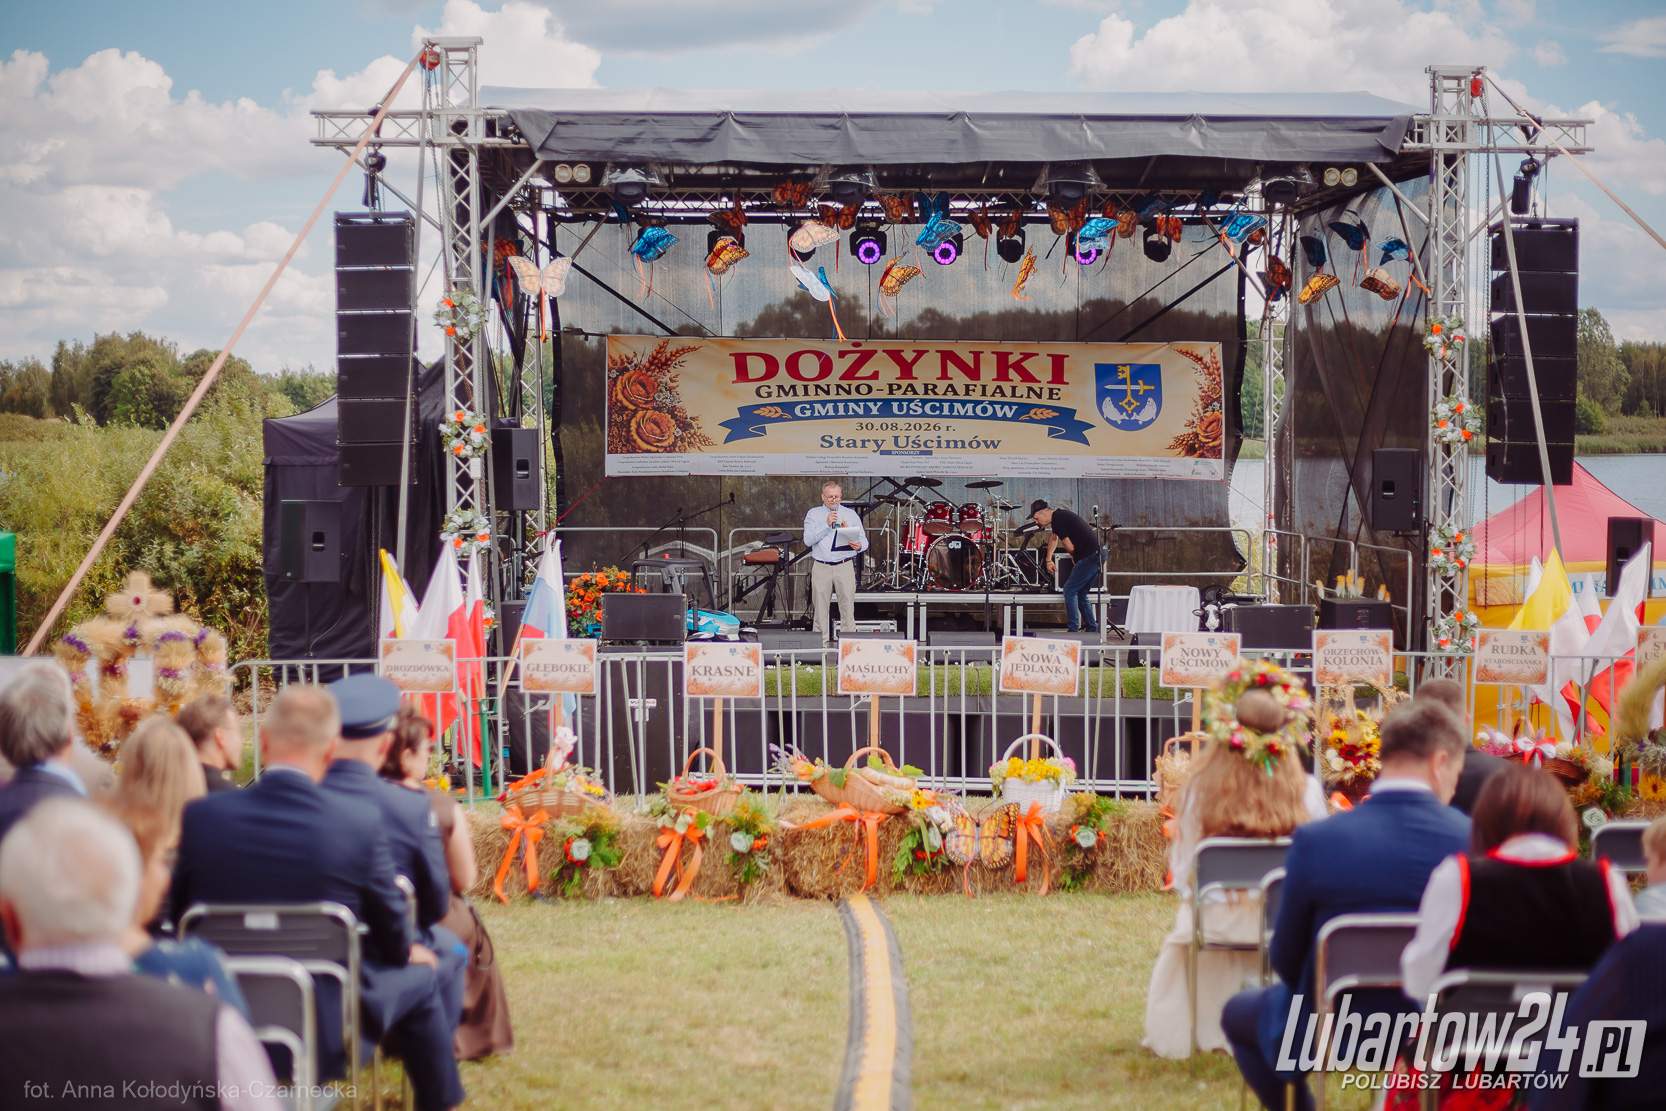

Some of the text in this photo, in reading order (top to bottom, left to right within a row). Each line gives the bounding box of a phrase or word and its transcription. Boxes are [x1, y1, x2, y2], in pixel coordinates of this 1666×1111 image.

[728, 341, 1070, 385] DOŻYNKI
[755, 382, 1062, 400] GMINNO-PARAFIALNE
[794, 399, 1018, 418] GMINY UŚCIMÓW
[855, 422, 956, 432] 30.08.2026 r.
[819, 434, 1002, 453] Stary Uścimów
[1180, 647, 1222, 658] NOWY
[1491, 644, 1537, 656] RUDKA
[1020, 652, 1061, 664] NOWA
[1323, 656, 1384, 666] KOLONIA
[691, 664, 756, 677] KRASNE
